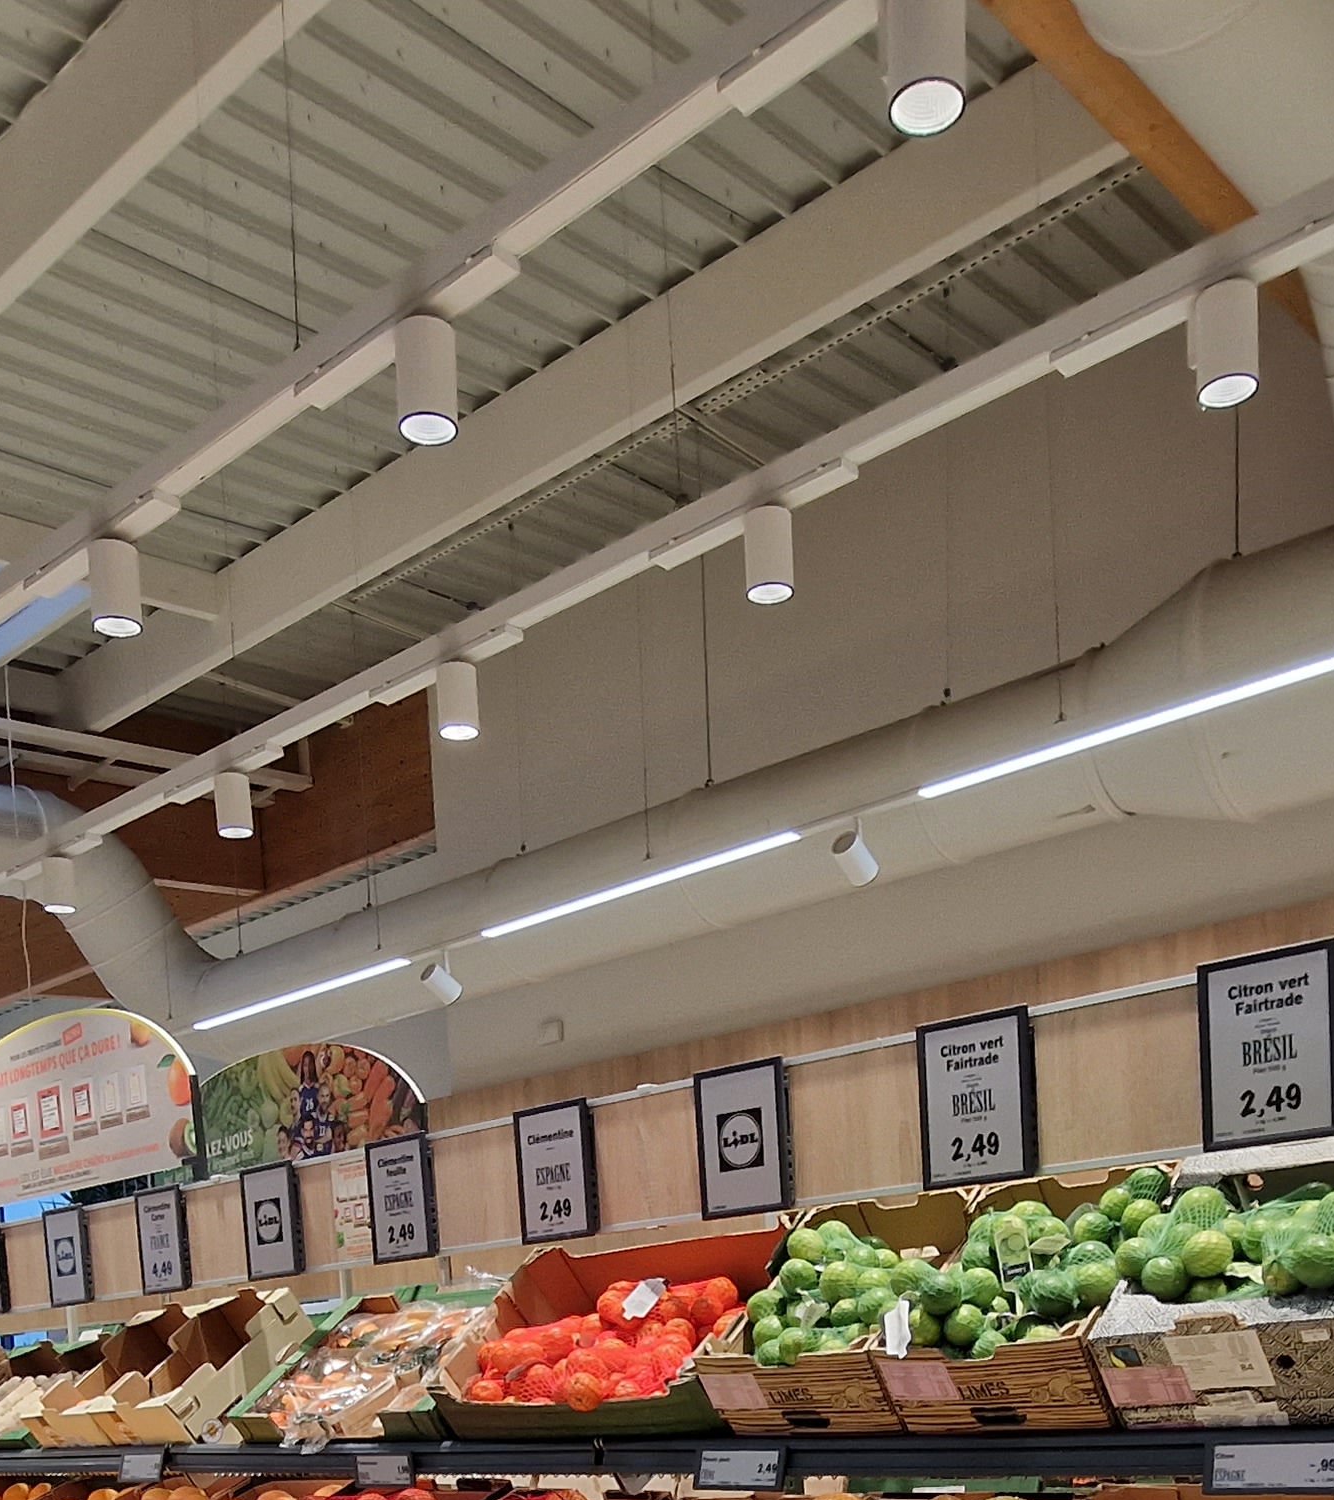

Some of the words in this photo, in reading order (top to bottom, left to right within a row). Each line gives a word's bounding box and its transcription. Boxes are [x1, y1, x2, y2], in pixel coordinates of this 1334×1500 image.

[1227, 981, 1274, 1001] Citron
[1278, 972, 1310, 991] vert
[1235, 992, 1304, 1016] Fairtrade
[940, 1042, 976, 1058] Citron
[979, 1035, 1005, 1051] vert
[1241, 1033, 1298, 1068] BRÉSIL
[8, 1057, 57, 1086] LONGTEMPS
[58, 1049, 77, 1071] QUE
[77, 1045, 90, 1063] ÇA
[91, 1036, 116, 1058] DURE
[946, 1052, 1000, 1073] Fairtrade
[952, 1088, 997, 1117] BRÉSIL
[1239, 1082, 1302, 1118] 2,49
[526, 1127, 575, 1146] Clémentine
[722, 1129, 759, 1149] LIDL
[951, 1131, 1000, 1162] 2,49
[376, 1154, 415, 1170] Clémentine
[535, 1162, 572, 1187] ESPAGNE
[383, 1190, 414, 1212] ESPAGNE
[538, 1197, 572, 1223] 2,49
[257, 1214, 280, 1227] LIDL
[387, 1222, 415, 1245] 2,49
[151, 1260, 173, 1279] 4,49
[768, 1386, 814, 1405] LIMES
[957, 1380, 1010, 1401] LIMES
[757, 1462, 778, 1475] 2,49
